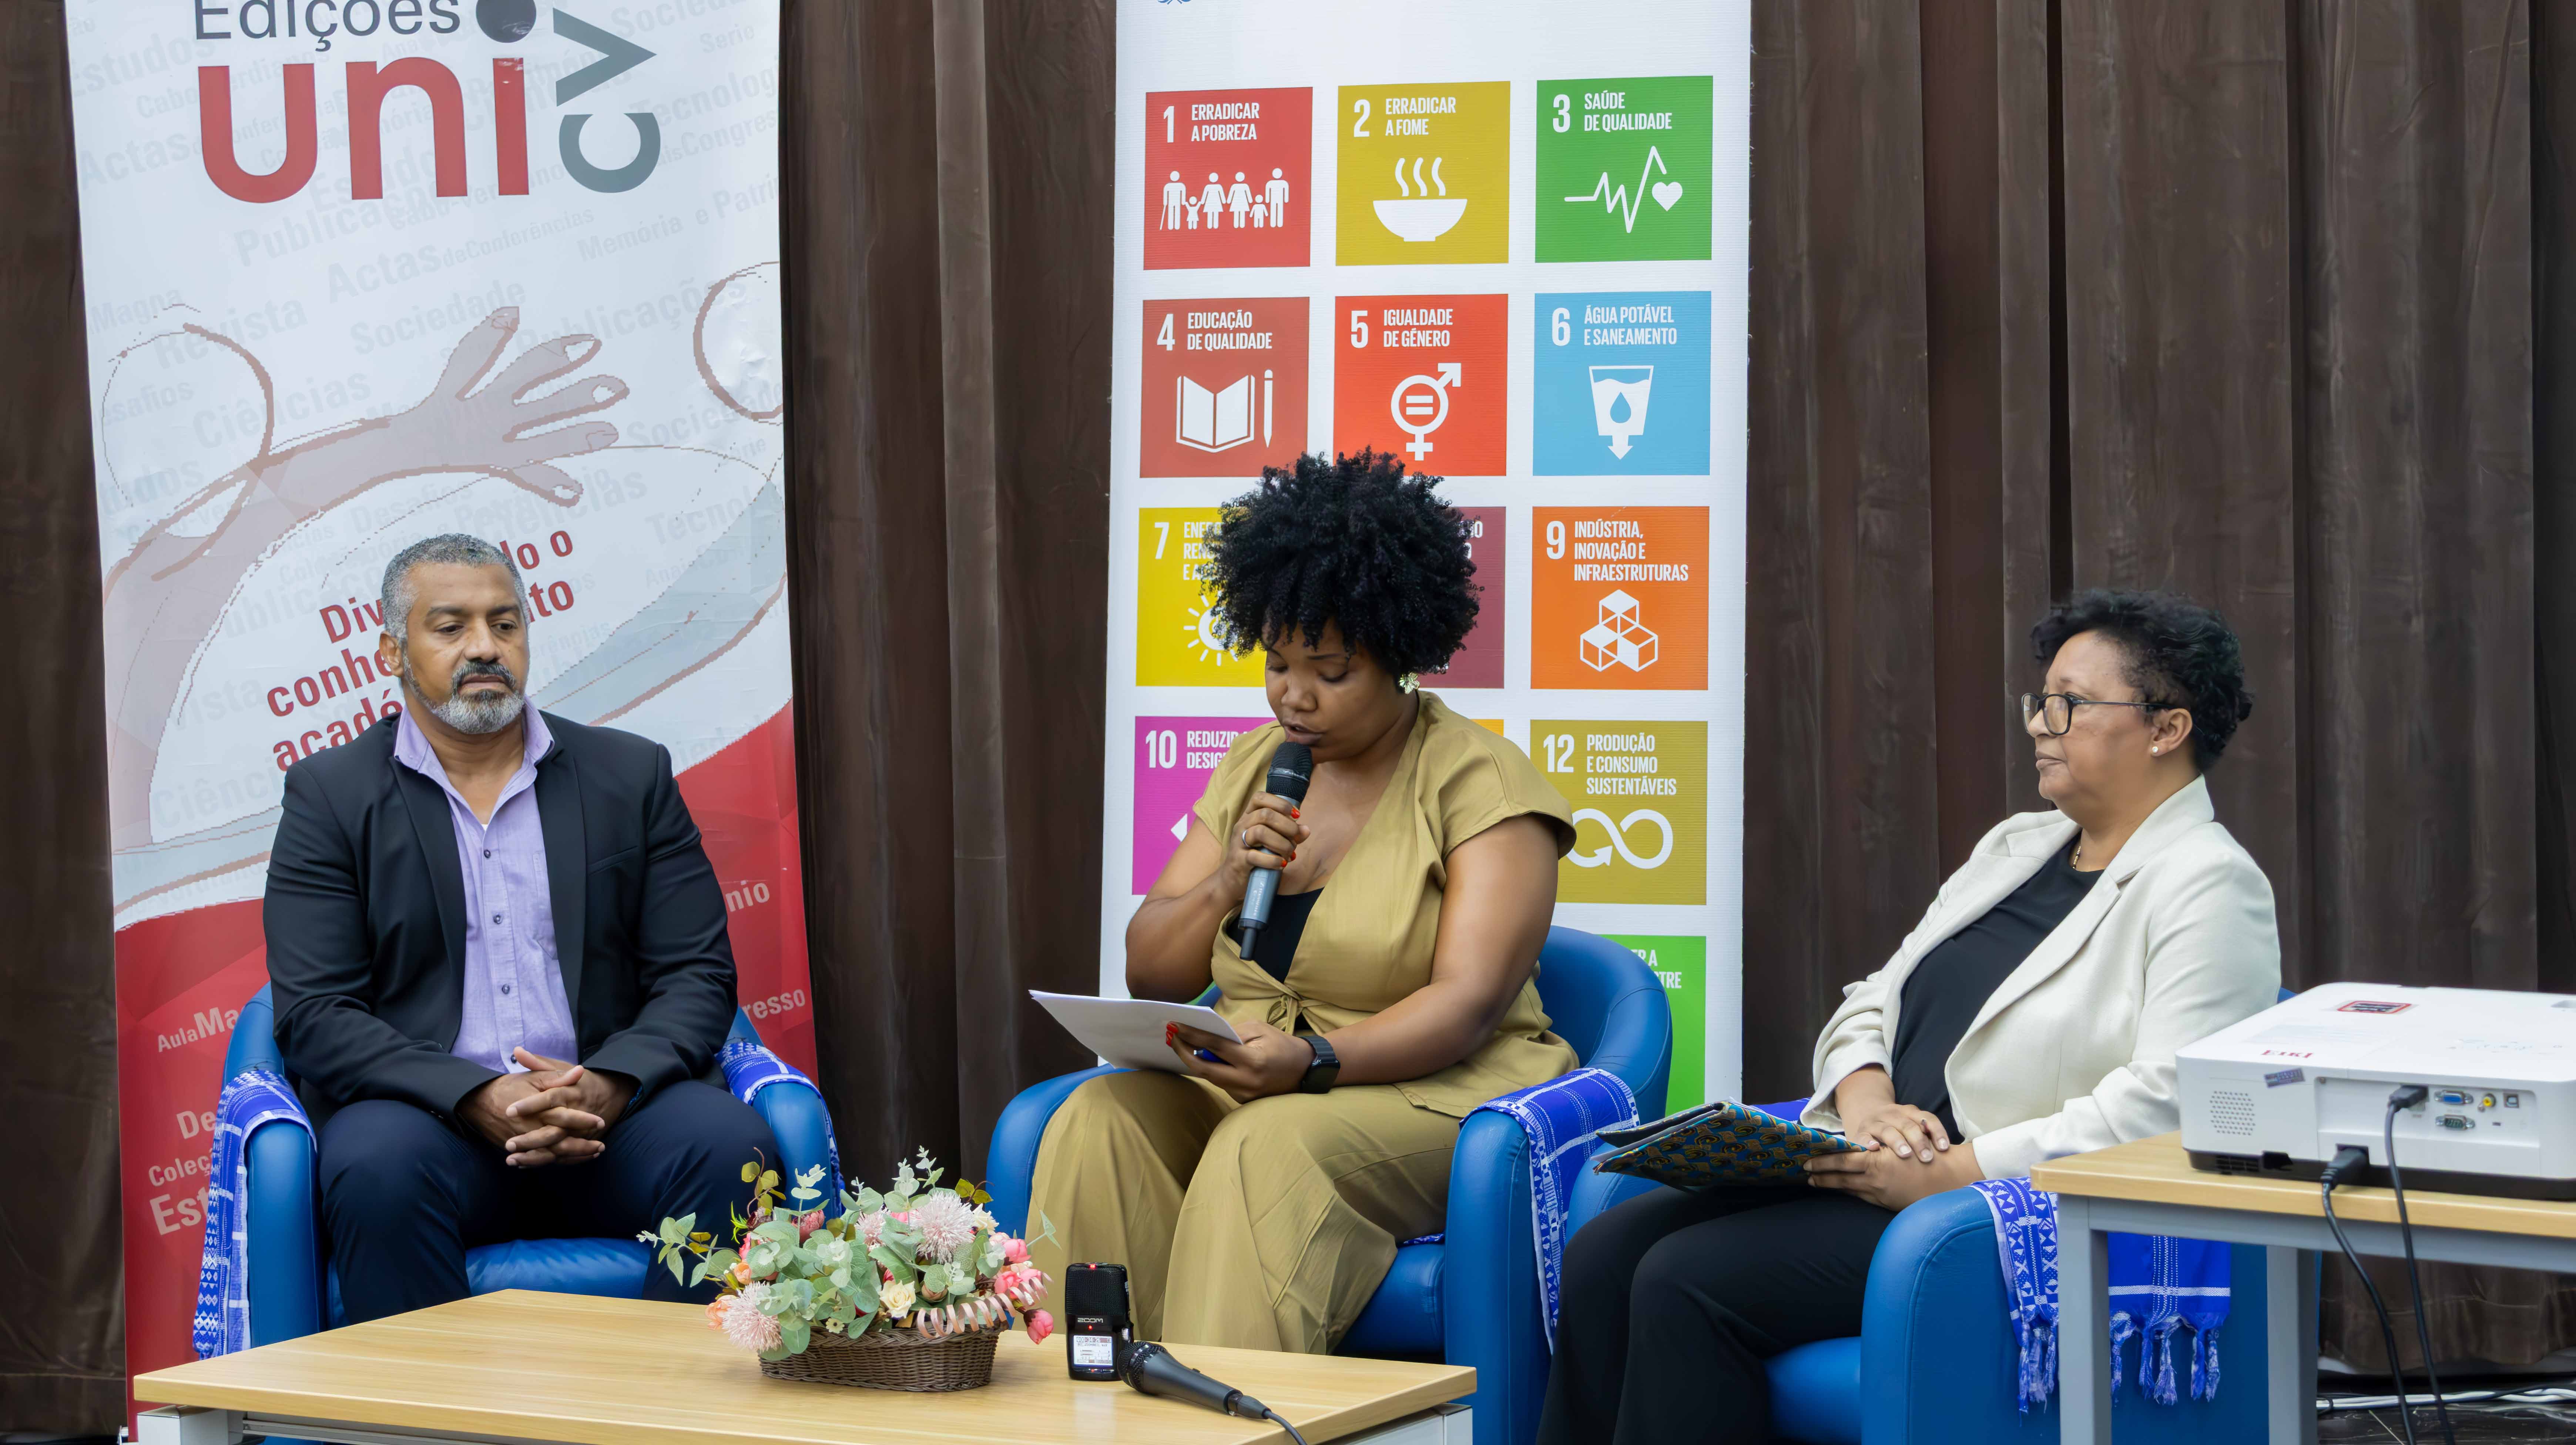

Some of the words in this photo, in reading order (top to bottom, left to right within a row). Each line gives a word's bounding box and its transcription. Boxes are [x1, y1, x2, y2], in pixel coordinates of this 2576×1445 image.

[1163, 105, 1175, 143] 1
[1191, 102, 1260, 121] ERRADICAR
[1353, 99, 1371, 137] 2
[1385, 97, 1456, 115] ERRADICAR
[1552, 94, 1571, 133] 3
[1584, 90, 1626, 110] SAÚDE
[1584, 114, 1600, 132] DE
[1602, 113, 1673, 133] QUALIDADE
[1191, 125, 1200, 142] A
[1202, 123, 1257, 141] POBREZA
[1385, 119, 1394, 136] A
[1396, 118, 1429, 136] FOME
[1157, 314, 1175, 351] 4
[1187, 309, 1253, 331] EDUCAÇÃO
[1351, 310, 1368, 349] 5
[1383, 309, 1453, 326] IGUALDADE
[1383, 331, 1399, 347] DE
[1401, 328, 1450, 347] GÉNERO
[1552, 307, 1571, 346] 6
[1584, 305, 1618, 324] ÁGUA
[1620, 304, 1674, 323] POTÁVEL
[1584, 329, 1591, 346] E
[1593, 328, 1677, 345] SANEAMENTO
[1187, 333, 1203, 350] DE
[1204, 332, 1273, 352] QUALIDADE
[1154, 522, 1170, 560] 7
[1546, 520, 1566, 560] 9
[1574, 518, 1644, 539] INDÚSTRIA,
[1574, 540, 1636, 561] INOVAÇÃO
[1638, 543, 1646, 559] E
[1574, 564, 1689, 581] INFRAESTRUTURAS
[1145, 730, 1177, 769] 10
[1543, 734, 1575, 773] 12
[1586, 732, 1655, 754] PRODUÇÃO
[1586, 756, 1594, 773] E
[1596, 756, 1658, 773] CONSUMO
[1586, 775, 1677, 795] SUSTENTÁVEIS
